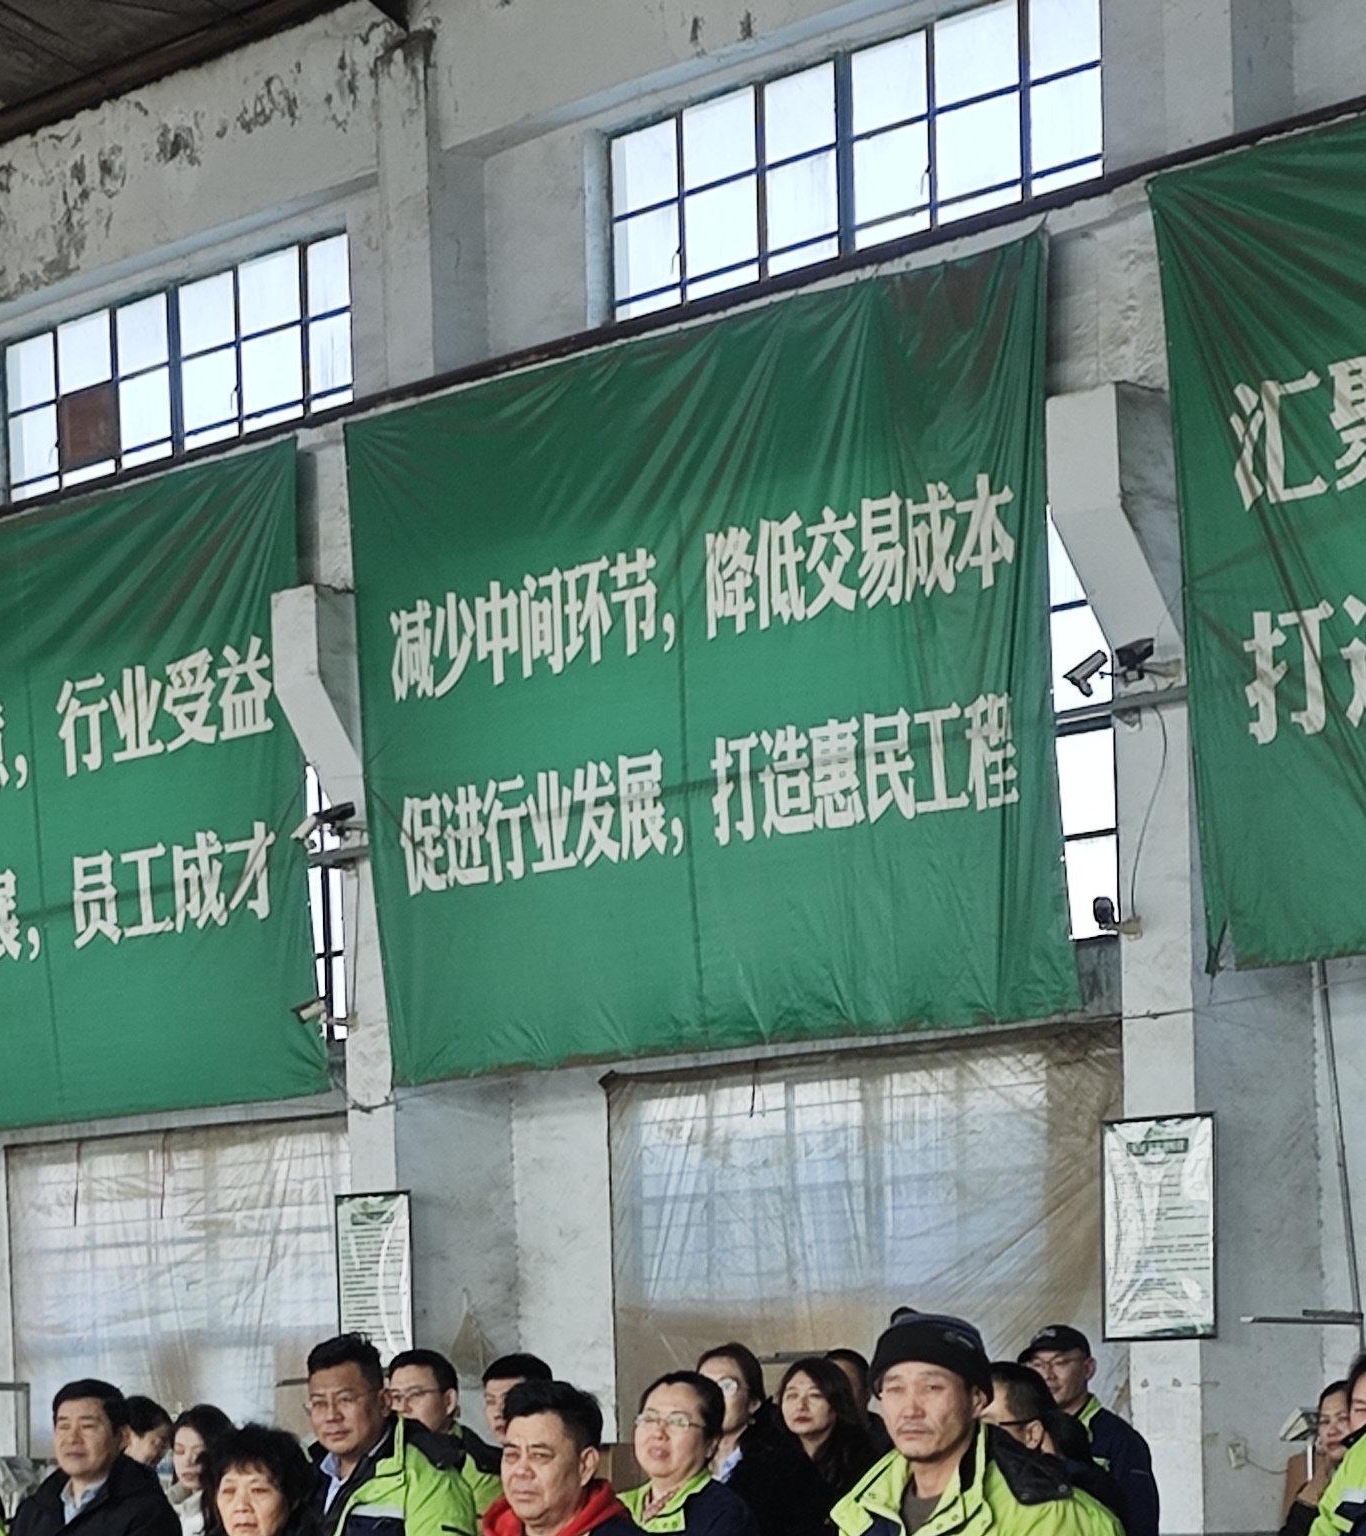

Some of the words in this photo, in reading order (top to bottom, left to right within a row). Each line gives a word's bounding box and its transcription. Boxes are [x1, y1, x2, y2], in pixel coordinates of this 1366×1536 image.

[390, 474, 1015, 702] 减少中间环节，降低交易成本
[400, 692, 1021, 897] 促进行业发展，打造惠民工程
